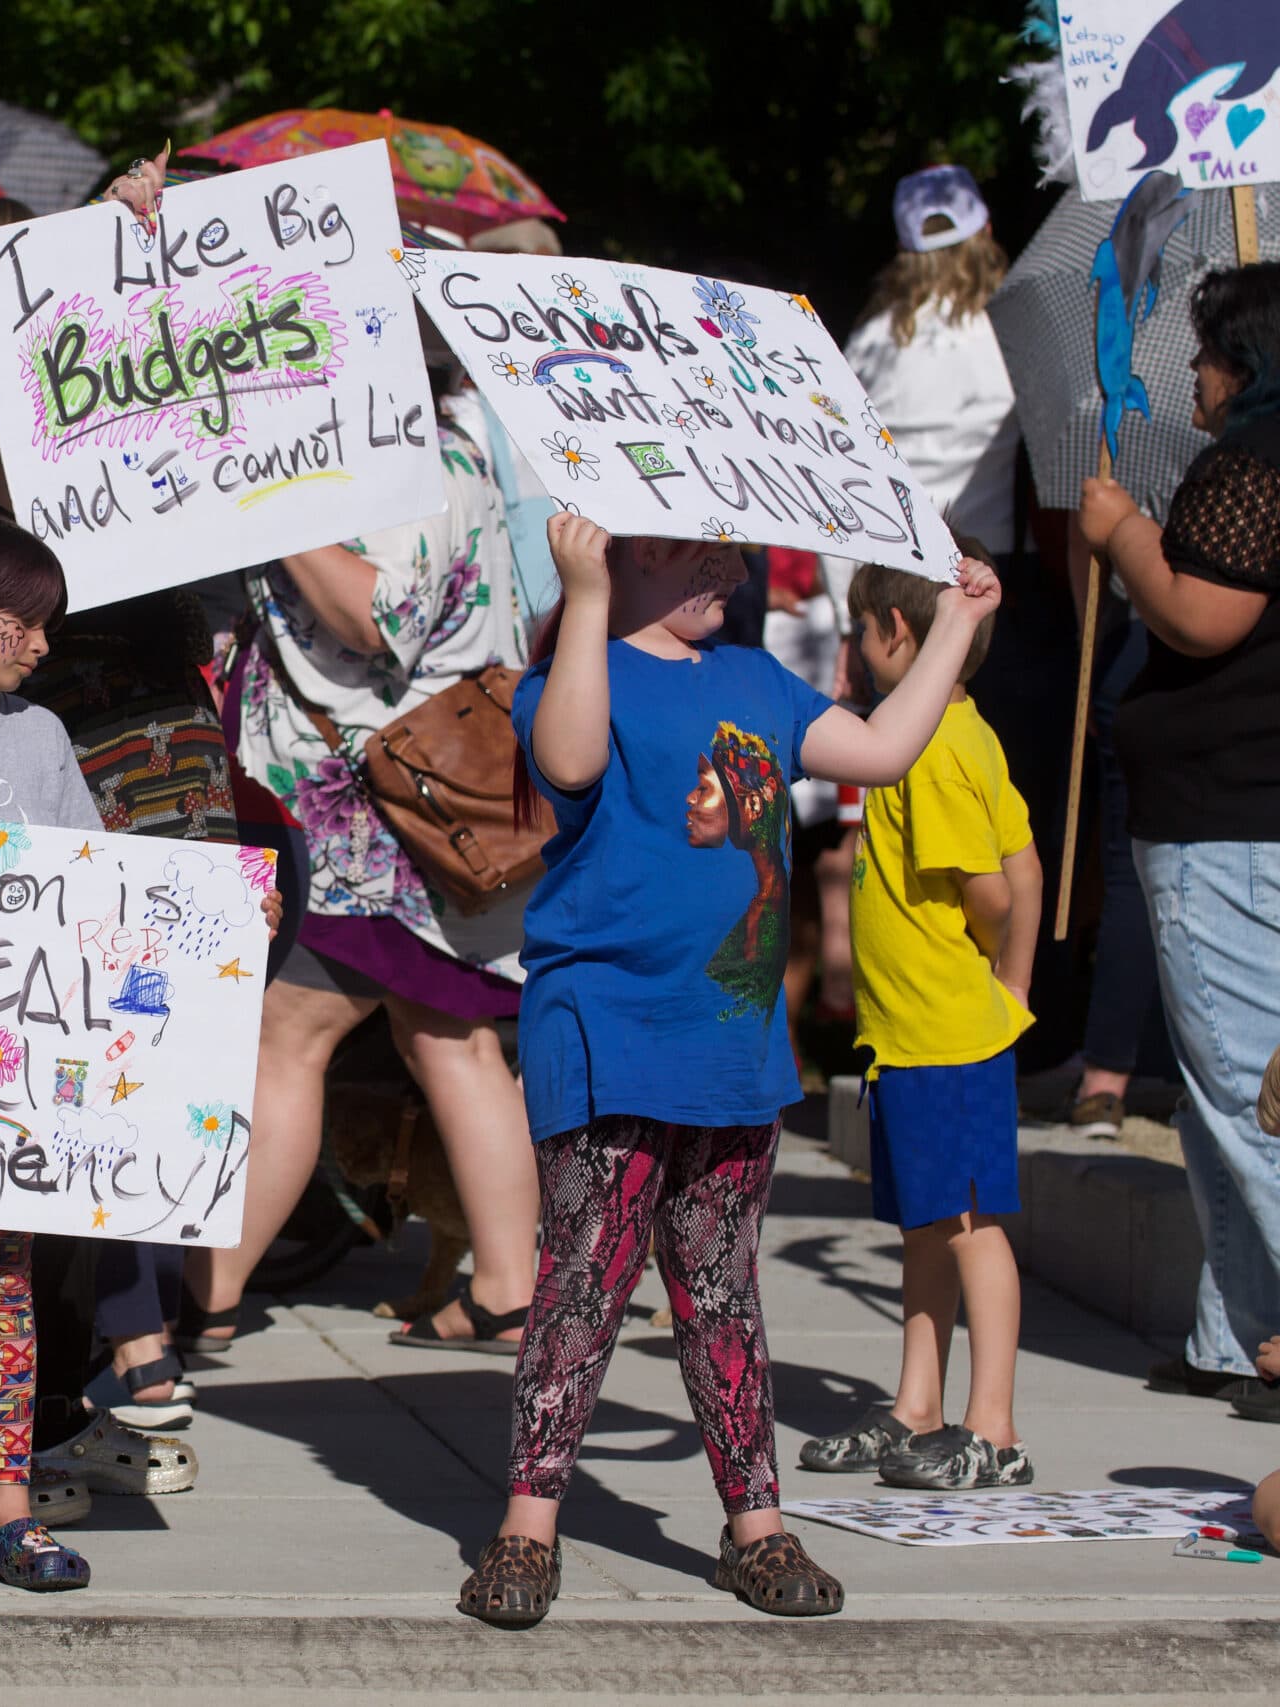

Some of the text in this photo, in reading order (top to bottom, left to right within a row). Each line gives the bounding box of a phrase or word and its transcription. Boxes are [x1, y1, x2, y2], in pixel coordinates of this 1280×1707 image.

[265, 183, 356, 268] Big
[441, 271, 699, 366] Schools
[42, 300, 318, 436] Budgets
[31, 383, 426, 540] and I cannot Lie
[546, 373, 873, 471] want to have
[615, 440, 924, 561] FUNDS!
[118, 861, 182, 926] is
